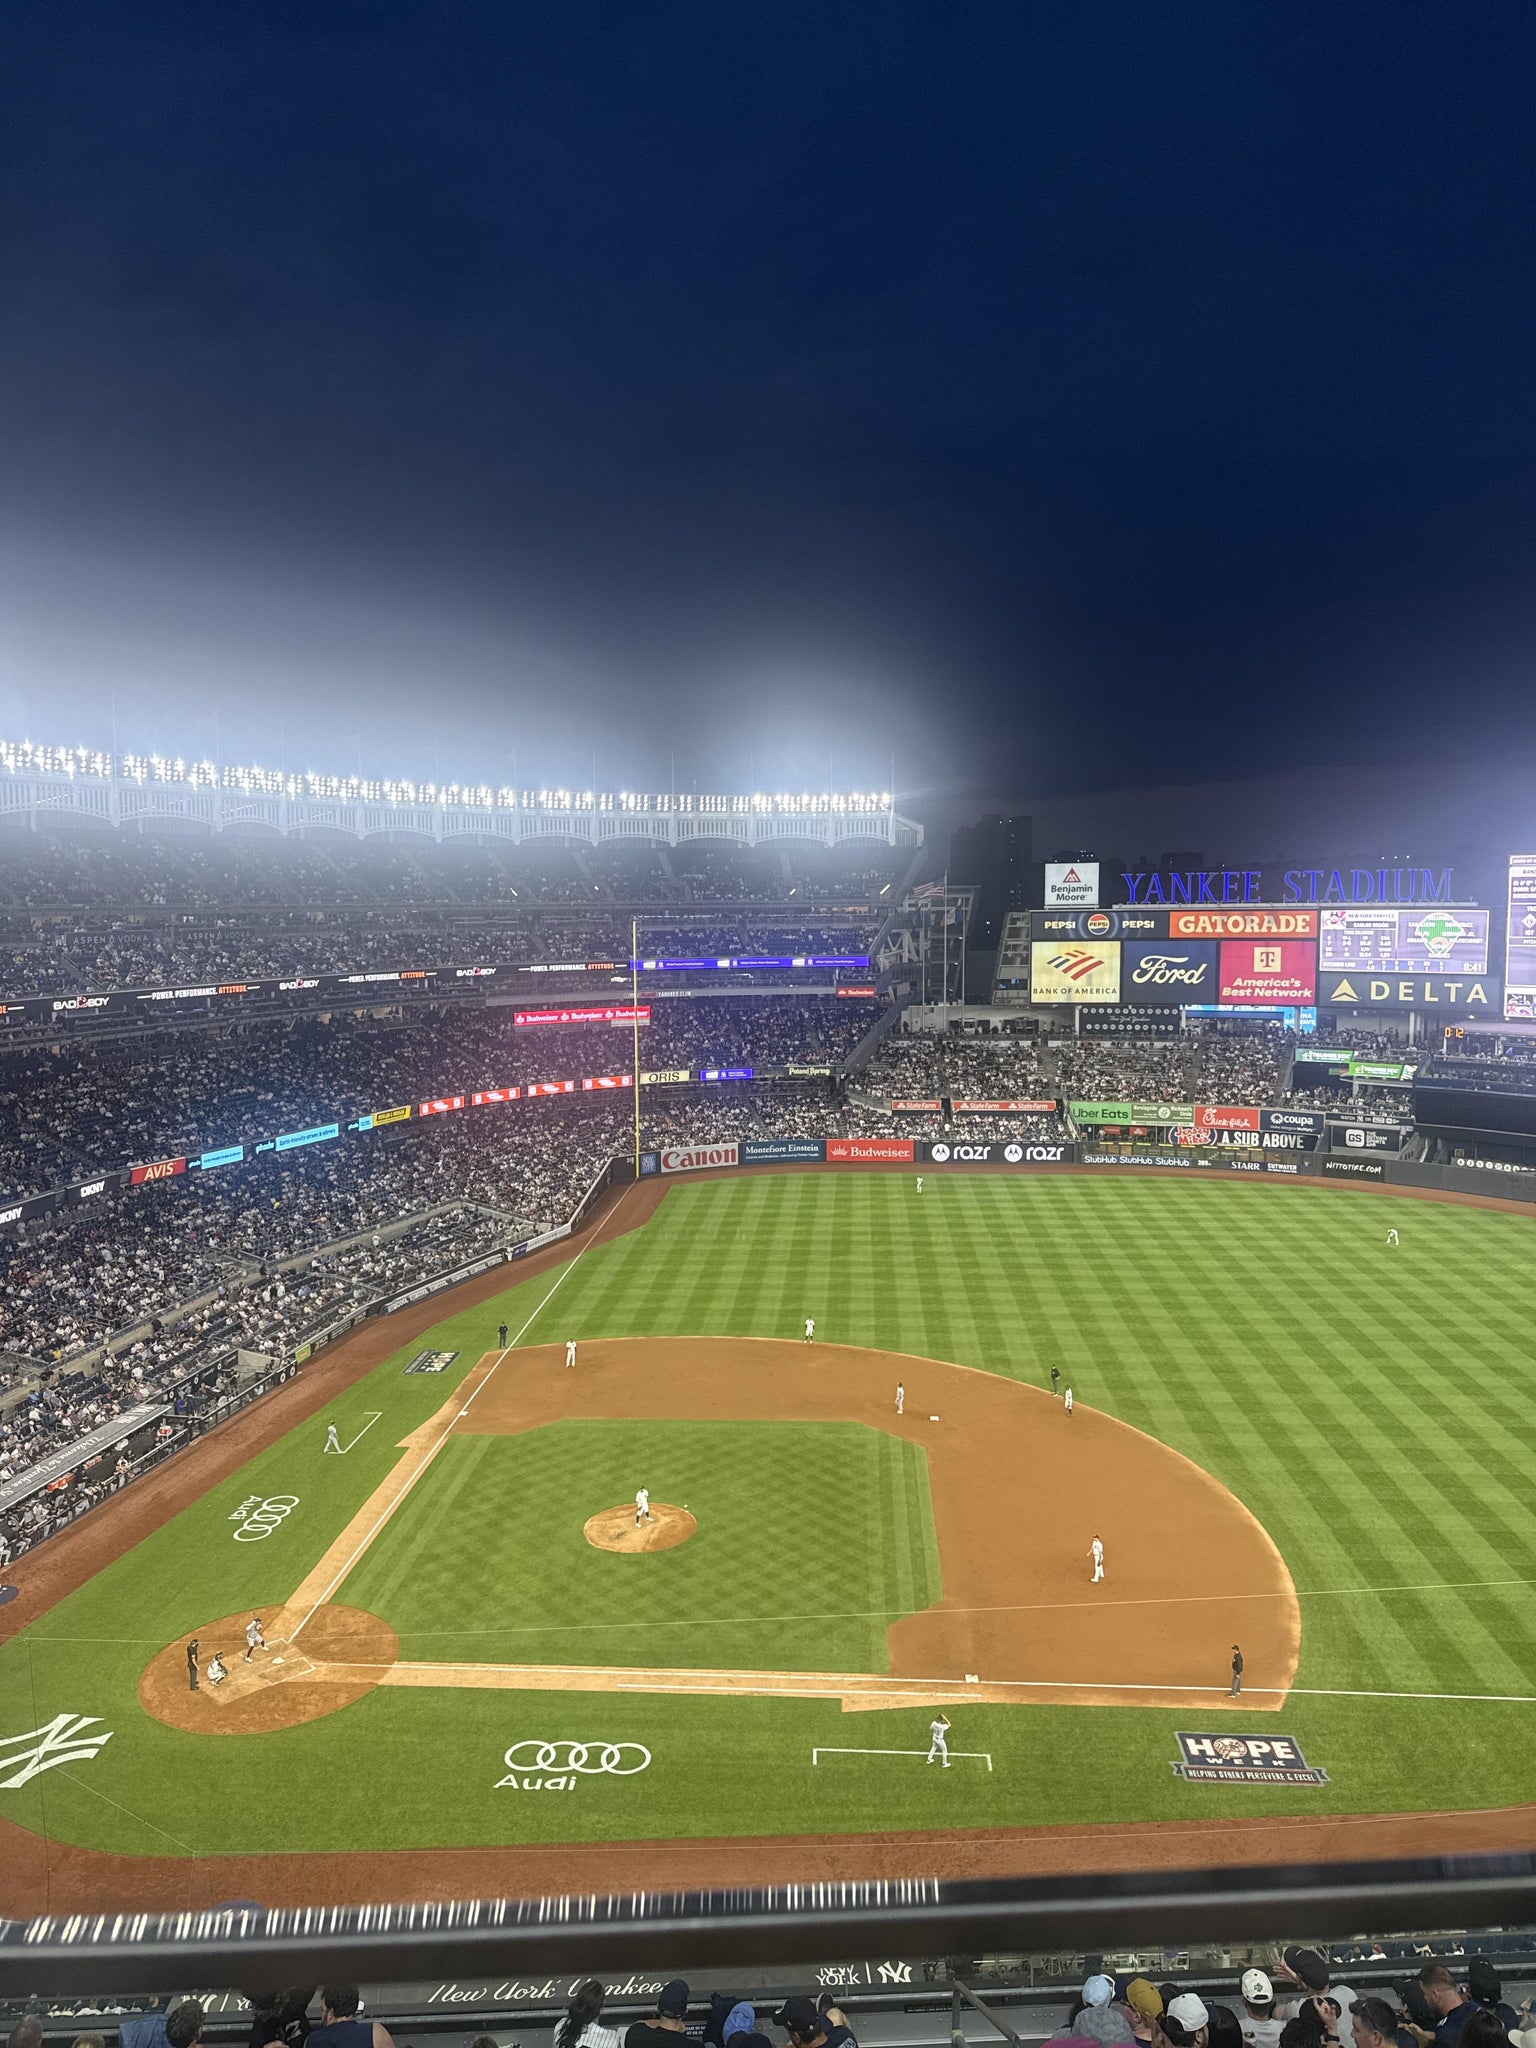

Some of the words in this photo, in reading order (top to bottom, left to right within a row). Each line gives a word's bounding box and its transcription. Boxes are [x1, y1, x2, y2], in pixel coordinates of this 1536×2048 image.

[1051, 884, 1093, 894] Benjamin
[1120, 871, 1262, 904] YANKEE
[1282, 868, 1454, 904] STADIUM
[1056, 894, 1086, 903] Moore
[1044, 920, 1076, 930] PEPSI
[1122, 920, 1155, 930] PEPSI
[1178, 914, 1310, 935] GATORADE
[1132, 955, 1208, 985] Ford
[1463, 963, 1482, 972] 8:41
[401, 971, 426, 979] ATTITUDE
[218, 984, 248, 995] ATTITUDE
[1232, 978, 1302, 990] America's
[1221, 987, 1252, 997] Best
[1253, 988, 1313, 1000] Network
[1370, 981, 1489, 1005] DELTA
[53, 1001, 77, 1010] BAD
[87, 997, 110, 1007] BOY
[527, 1014, 558, 1022] Budweiser
[571, 1012, 603, 1020] Budweiser
[649, 1073, 680, 1083] ORIS
[810, 1068, 831, 1076] Spring
[1073, 1108, 1100, 1119] Uber
[1101, 1109, 1128, 1119] Eats
[1284, 1116, 1313, 1126] coupa
[1222, 1131, 1230, 1144] A
[1234, 1132, 1260, 1147] SUB
[1262, 1133, 1304, 1149] ABOVE
[1348, 1134, 1362, 1142] GS
[746, 1145, 787, 1154] Montefiore
[788, 1144, 819, 1152] Einstein
[953, 1146, 991, 1160] razr
[1026, 1147, 1064, 1161] razr
[662, 1148, 737, 1170] Canon
[1084, 1155, 1117, 1165] StubHub
[1119, 1156, 1153, 1166] StubHub
[1155, 1157, 1190, 1167] StubHub
[144, 1162, 174, 1181] AVIS
[1231, 1161, 1261, 1171] STARR
[1267, 1163, 1297, 1171] CUTWATER
[1325, 1161, 1382, 1175] NITTOTIRE.COM
[81, 1180, 106, 1197] DKNY
[228, 1495, 262, 1520] Audi
[1184, 1737, 1296, 1760] HOPE
[1206, 1757, 1287, 1767] WEEK
[1188, 1769, 1217, 1779] HELPING
[1219, 1771, 1244, 1780] OTHERS
[1247, 1772, 1285, 1781] PERSEVERE
[1287, 1773, 1294, 1781] &
[1294, 1773, 1317, 1782] EXCEL
[492, 1774, 577, 1791] Audi
[820, 1964, 854, 1976] NEW
[877, 1961, 913, 1984] NY
[816, 1973, 861, 1986] YORK
[427, 1984, 488, 2003] New
[493, 1978, 563, 2001] York
